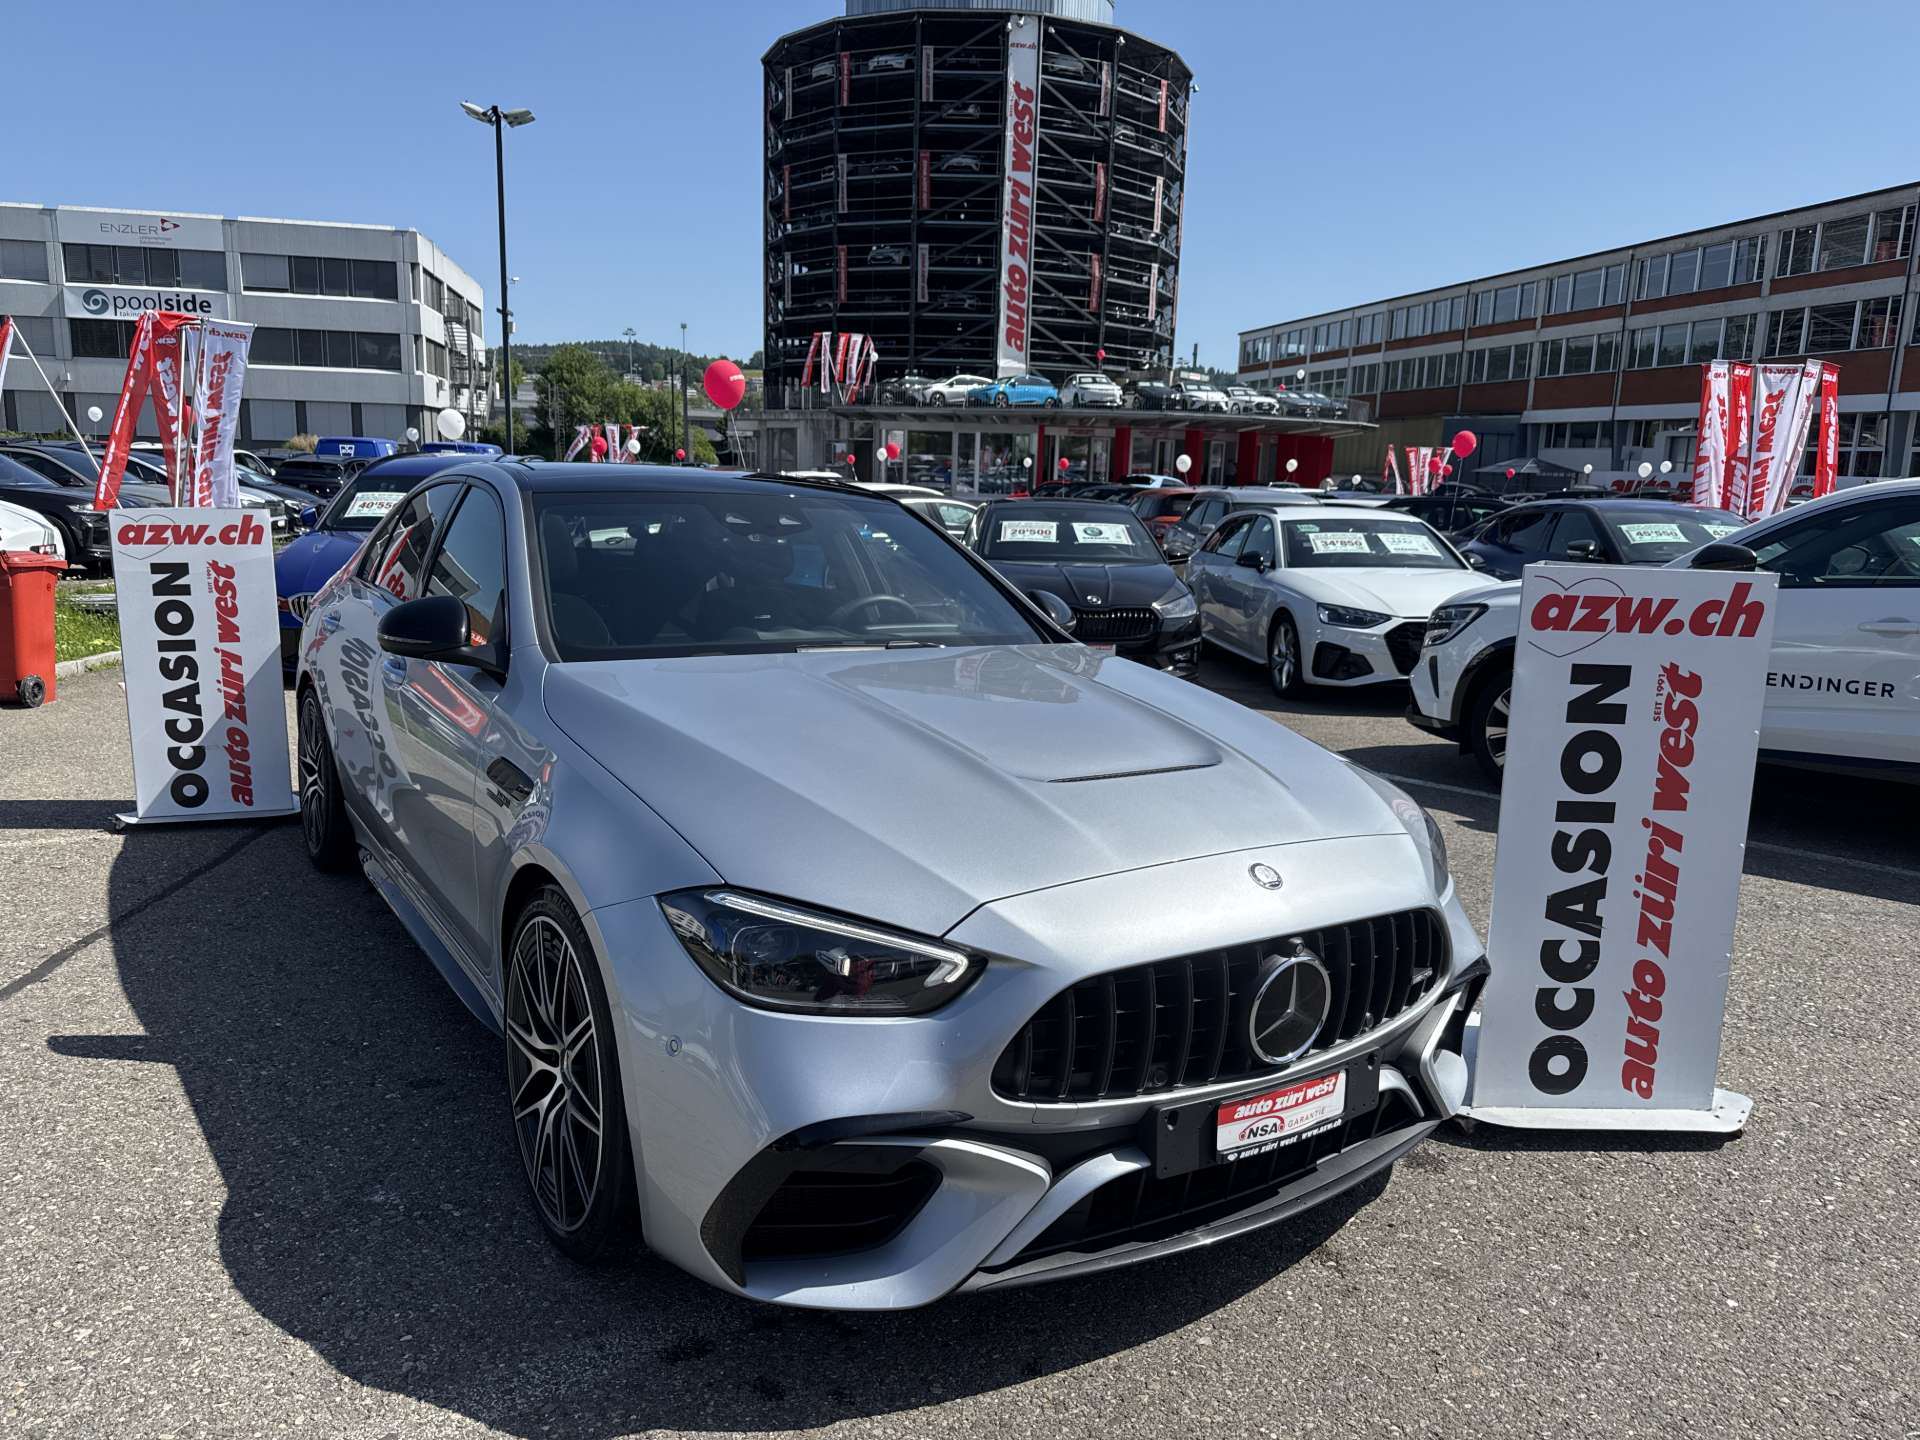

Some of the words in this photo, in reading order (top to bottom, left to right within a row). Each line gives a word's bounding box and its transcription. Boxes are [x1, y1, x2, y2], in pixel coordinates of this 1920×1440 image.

[1012, 80, 1035, 173] west
[100, 223, 158, 234] ENZLER
[1005, 176, 1031, 262] züri
[113, 292, 212, 316] poolside
[1004, 264, 1028, 352] auto
[117, 515, 265, 545] azw.ch
[206, 559, 241, 643] west
[1530, 582, 1765, 638] azw.ch
[149, 562, 210, 808] OCCASION
[213, 646, 248, 726] züri
[1653, 701, 1663, 722] SEIT
[1656, 673, 1666, 698] 1991
[1766, 671, 1896, 699] ENDINGER
[223, 726, 254, 807] auto
[1652, 661, 1703, 812] west
[1528, 663, 1632, 1095] OCCASION
[1632, 816, 1684, 959] züri
[1621, 958, 1666, 1099] auto
[1233, 1099, 1274, 1119] auto
[1275, 1088, 1306, 1109] züri
[1306, 1082, 1336, 1100] west
[1247, 1122, 1278, 1139] NSA
[1287, 1106, 1326, 1128] GARANTIE
[1240, 1147, 1259, 1159] auto
[1260, 1141, 1279, 1153] züri
[1280, 1135, 1299, 1147] west
